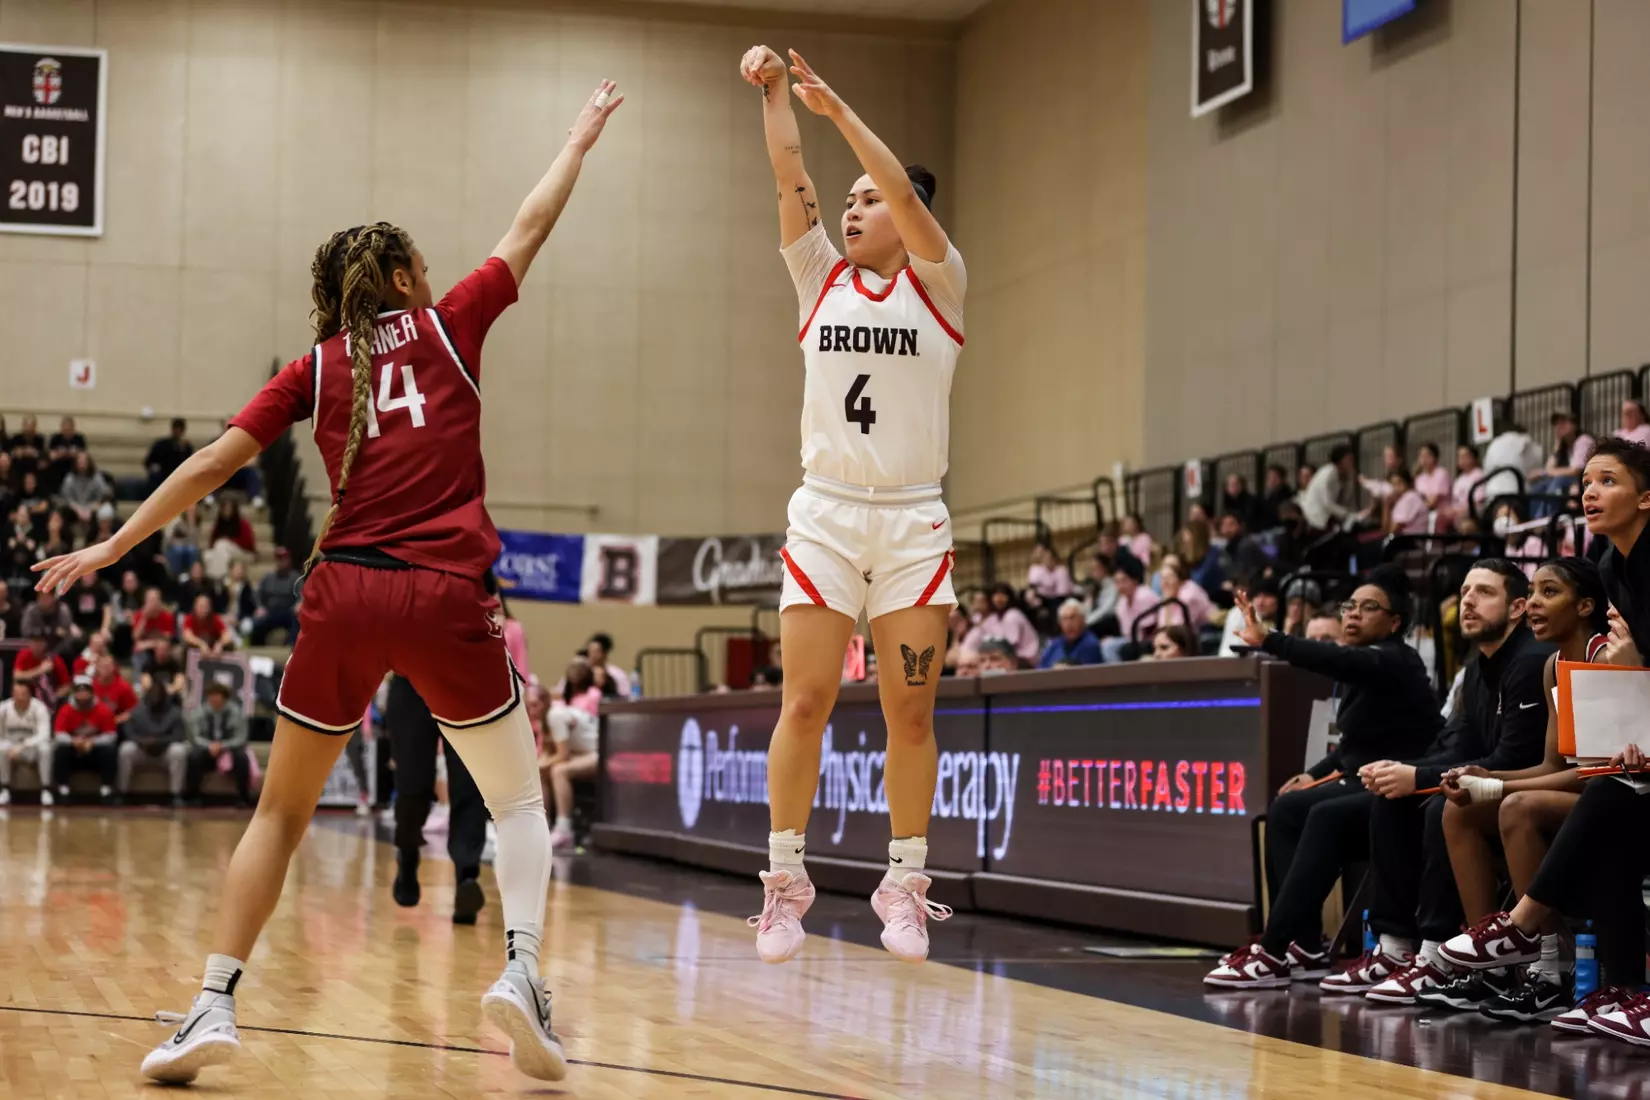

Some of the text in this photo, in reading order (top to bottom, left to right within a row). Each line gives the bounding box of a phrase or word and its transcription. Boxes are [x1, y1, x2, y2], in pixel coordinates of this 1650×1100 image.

[22, 133, 69, 166] CBI
[9, 179, 79, 213] 2019
[343, 314, 418, 357] TRNER
[76, 365, 90, 385] J
[844, 374, 876, 435] 4
[1477, 407, 1488, 434] L
[598, 546, 639, 602] B
[813, 723, 890, 846] Physica
[930, 751, 1020, 860] erapy
[1037, 759, 1247, 815] #BETTERFASTER
